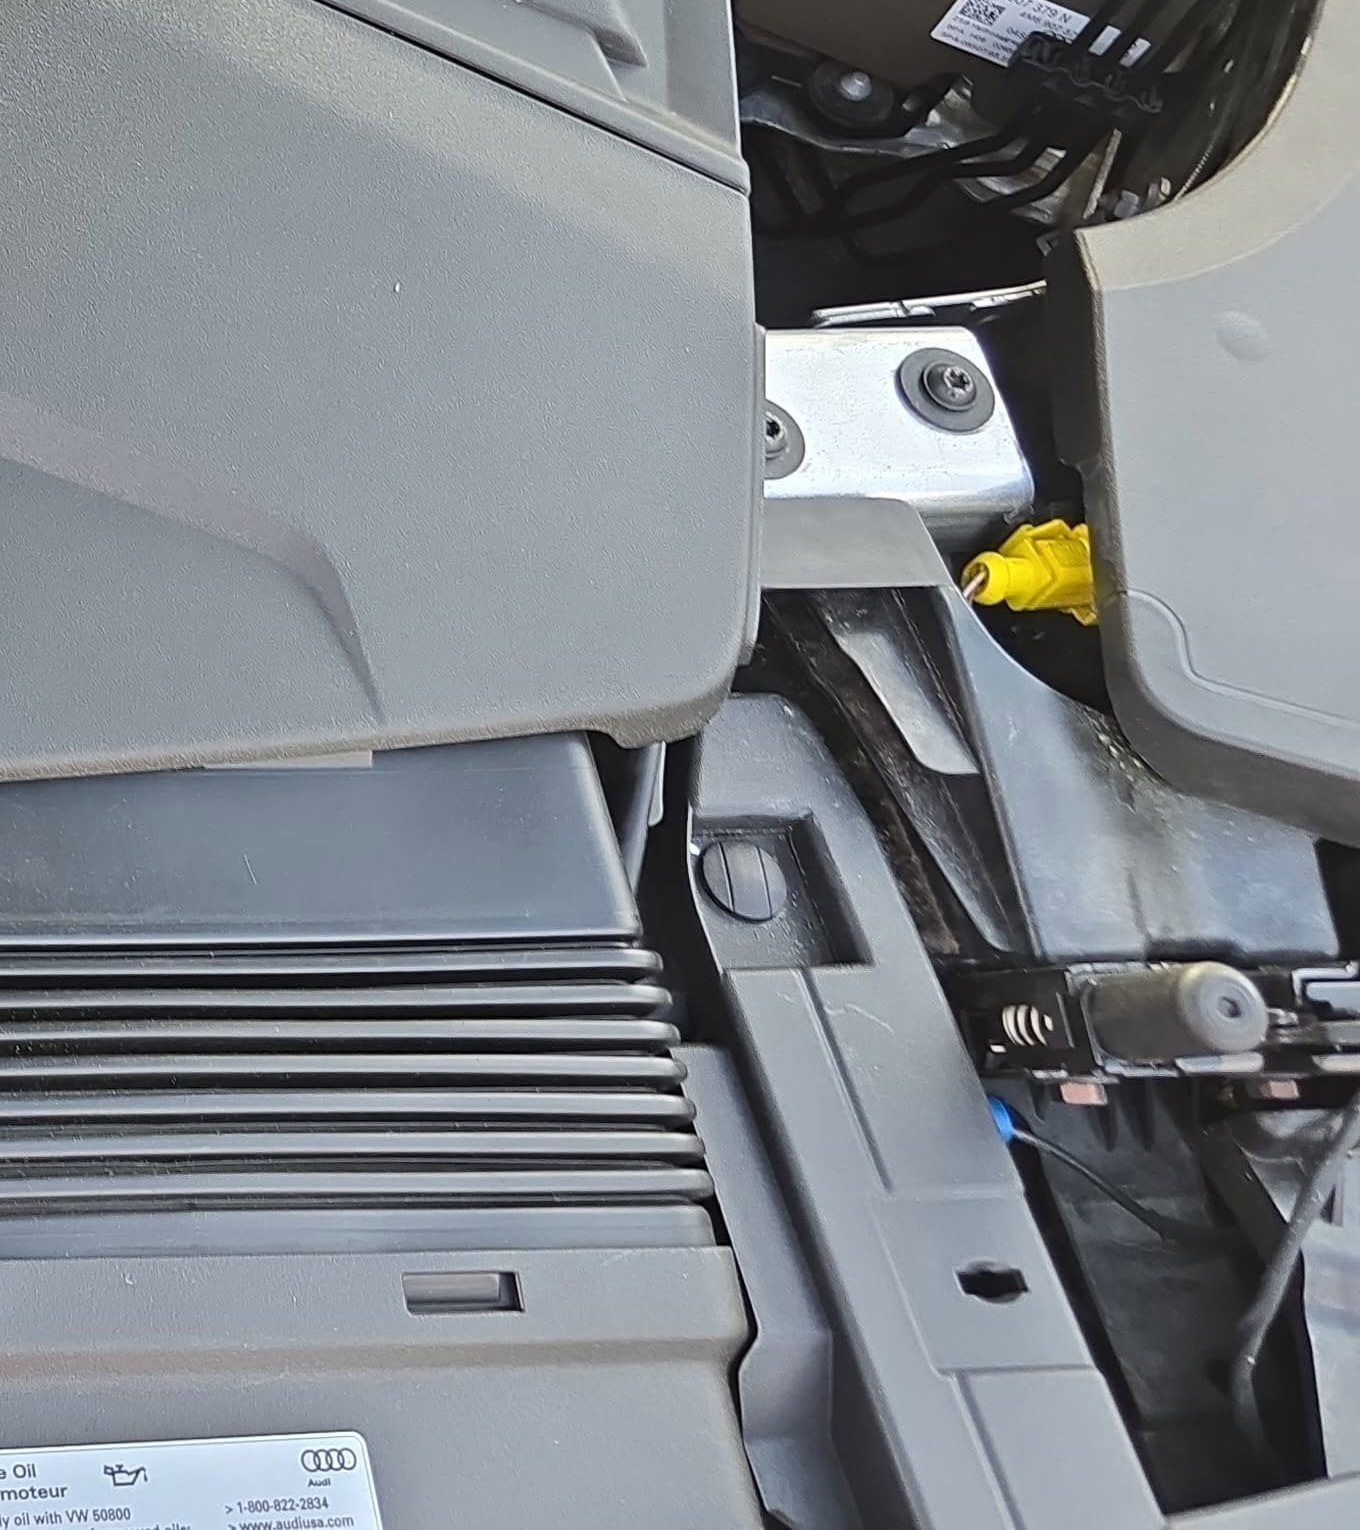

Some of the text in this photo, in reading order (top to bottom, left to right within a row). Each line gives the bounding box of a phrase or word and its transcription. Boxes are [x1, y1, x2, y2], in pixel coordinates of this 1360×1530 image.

[1032, 3, 1058, 19] 379
[1060, 12, 1072, 24] N
[13, 1463, 37, 1479] Oil
[307, 1478, 331, 1487] Audi
[0, 1485, 68, 1501] moteur
[236, 1497, 329, 1514] 1-800-822-2834
[14, 1512, 30, 1526] oil
[34, 1511, 62, 1525] with
[65, 1509, 88, 1523] VW
[92, 1507, 131, 1521] 50800
[239, 1515, 355, 1530] www.audiusa.com
